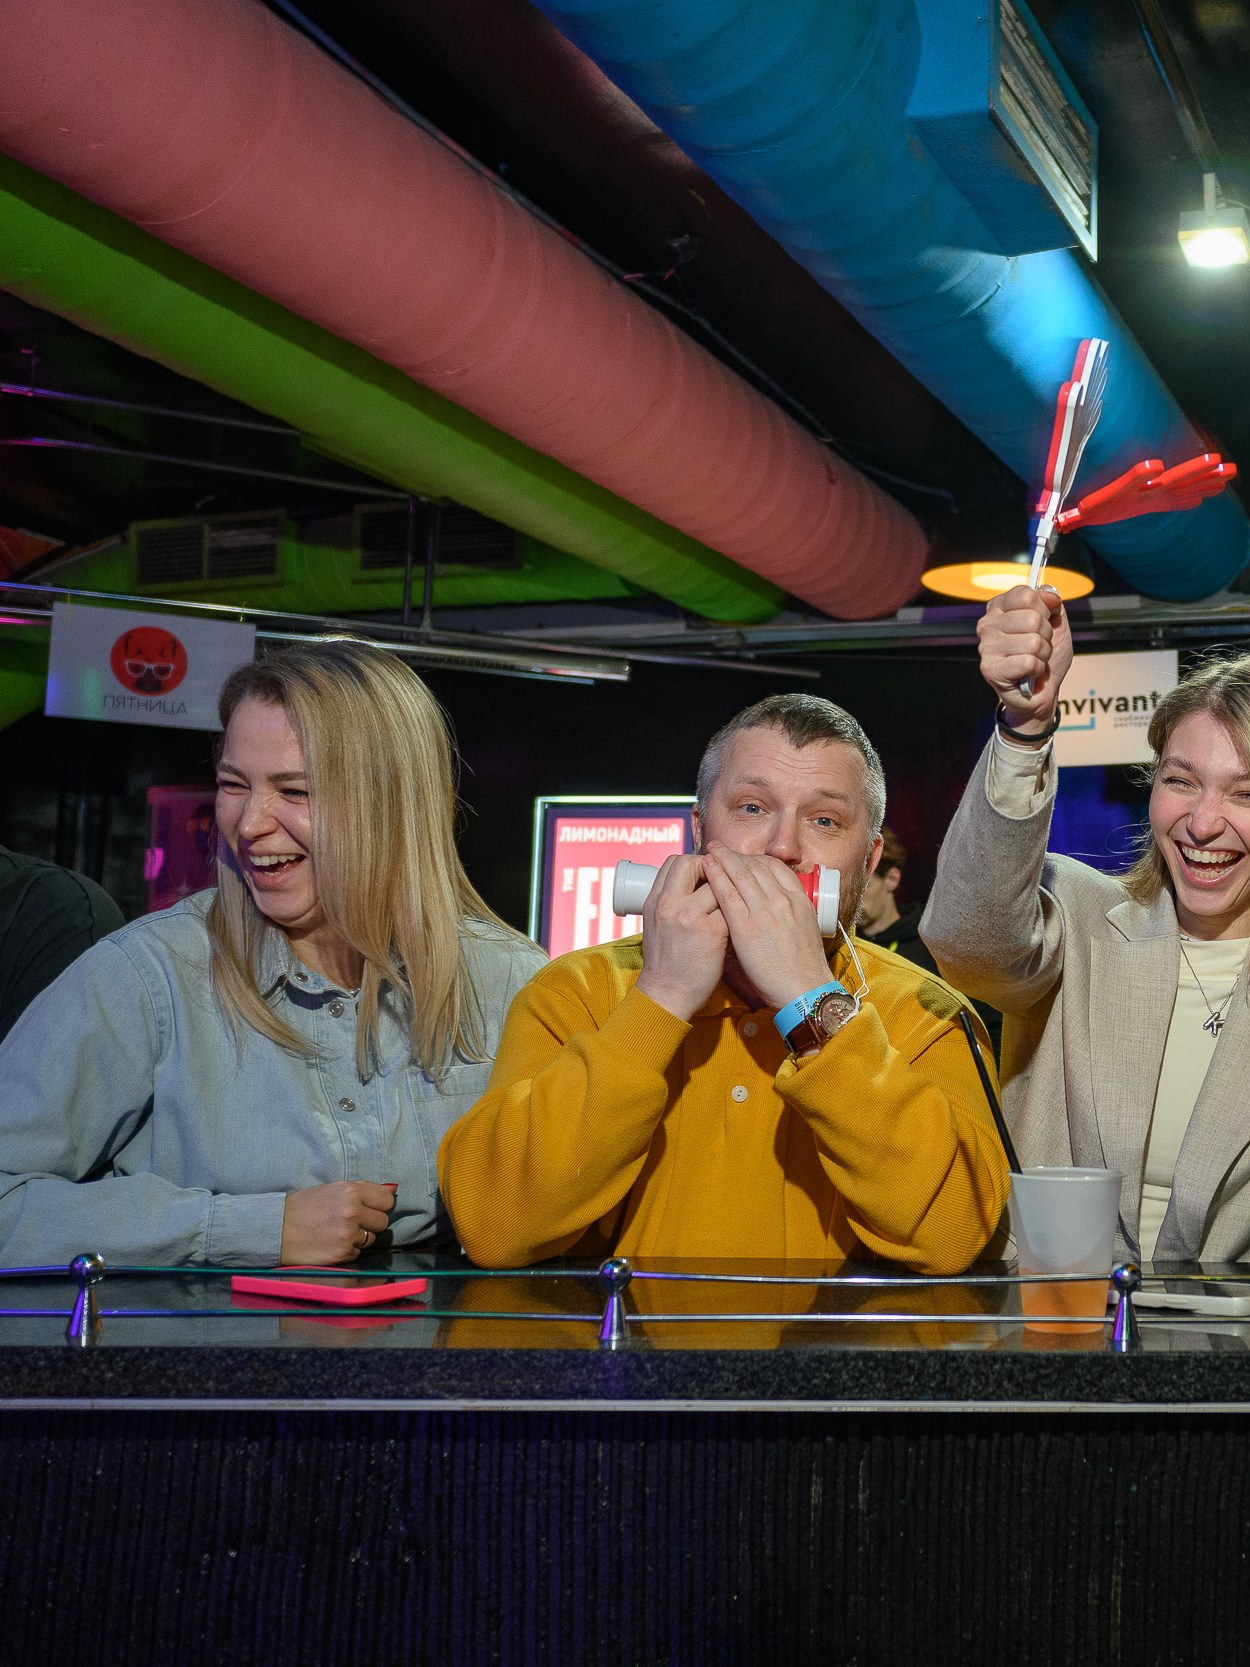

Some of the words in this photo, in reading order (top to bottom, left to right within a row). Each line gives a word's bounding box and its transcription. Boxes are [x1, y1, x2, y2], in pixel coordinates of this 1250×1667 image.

[103, 695, 188, 716] ПЯТНИЦА
[1058, 689, 1162, 716] nvivant
[559, 823, 681, 845] ЛИМОНАДНЫЙ
